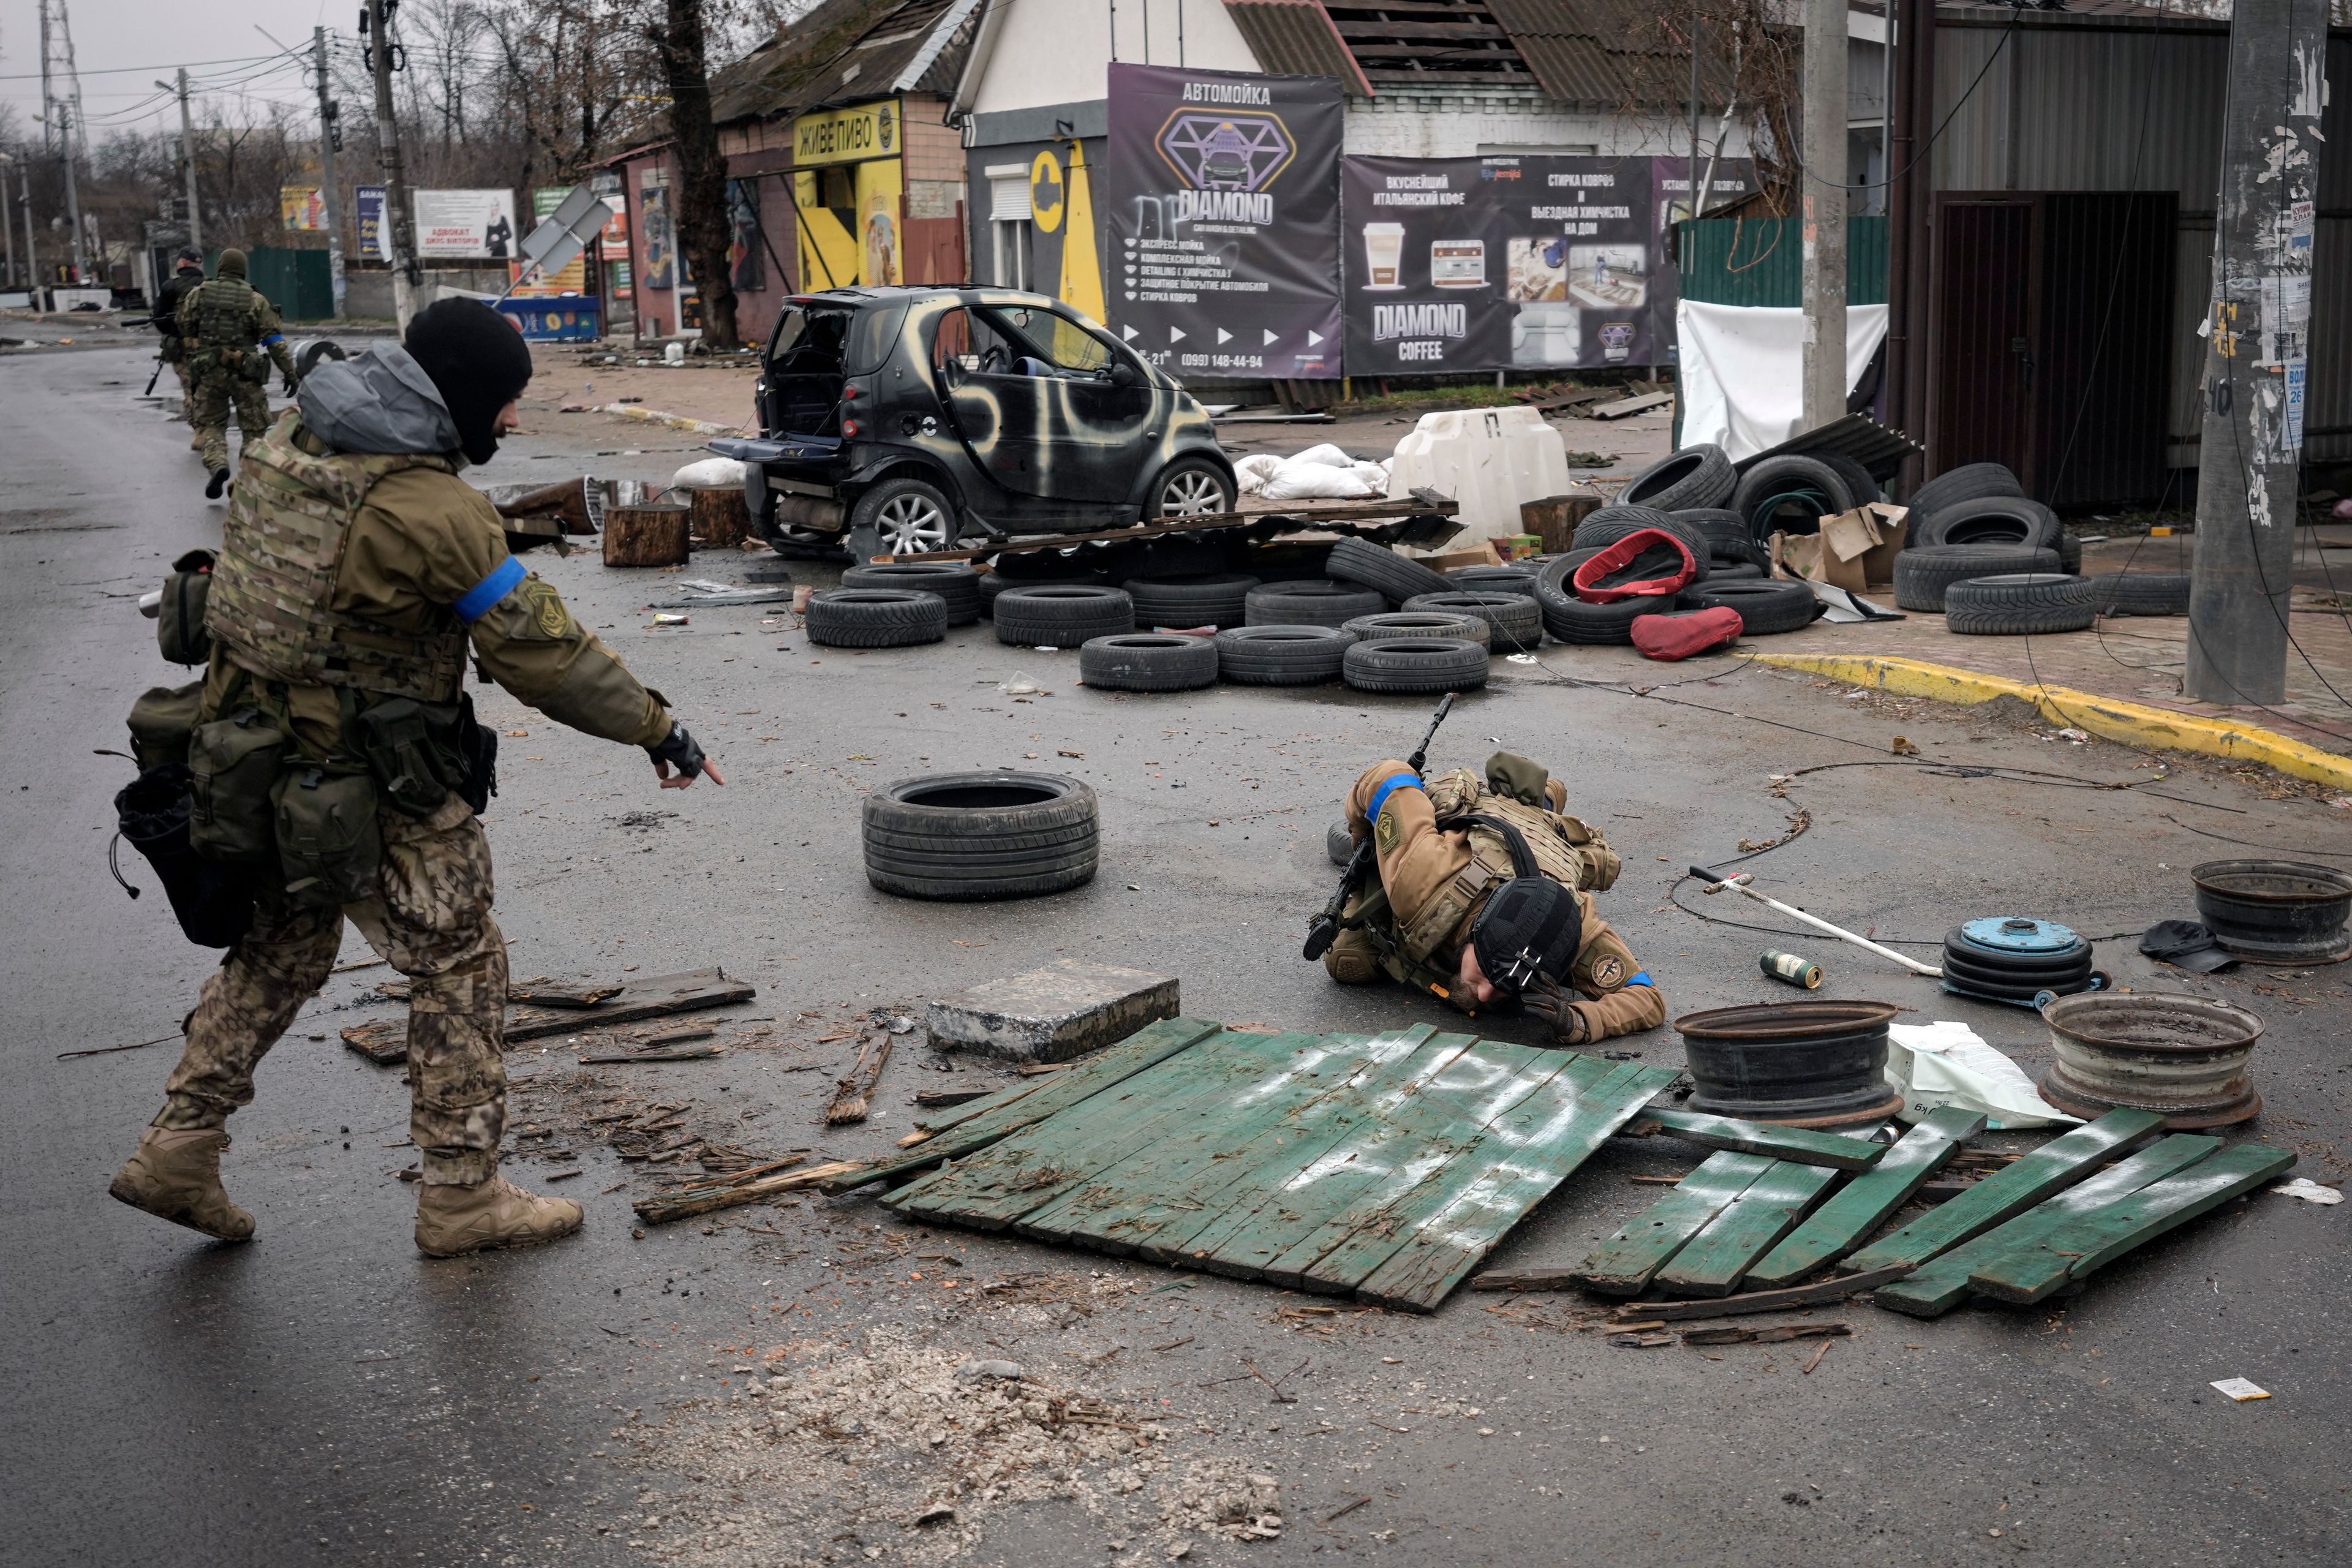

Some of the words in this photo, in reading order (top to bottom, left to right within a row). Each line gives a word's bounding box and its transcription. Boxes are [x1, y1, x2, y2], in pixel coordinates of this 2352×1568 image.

[1183, 82, 1272, 105] АВТОМОЙКА
[800, 123, 834, 156] ЖИВЕ
[837, 116, 872, 151] ПИВО
[1387, 175, 1449, 189] ВКУСНЕЙШИЙ
[1548, 174, 1581, 186] СТИРКА
[1581, 174, 1615, 186] КОВРОВ
[1373, 190, 1438, 205] ИТАЛЬЯНСКИЙ
[1440, 193, 1465, 205] КОФЕ
[1578, 190, 1585, 202] И
[1177, 189, 1273, 225] DIAMOND
[1532, 206, 1578, 219] ВЫЕЗДНАЯ
[1580, 206, 1630, 218] ХИМЧИСТКА
[2293, 203, 2311, 216] КУПИМ
[2293, 211, 2311, 222] ХЛАМ
[1564, 222, 1577, 235] НА
[1578, 222, 1597, 235] ДОМ
[1140, 239, 1178, 249] ЭКСПРЕСС
[1179, 239, 1204, 251] МОЙКА
[1140, 254, 1194, 264] КОМПЛЕКСНАЯ
[1195, 255, 1222, 265] МОЙКА
[1140, 266, 1176, 276] DETAILING
[1182, 268, 1226, 277] ХИМЧИСТКА
[1140, 279, 1179, 289] ЗАЩИТНОЕ
[1180, 279, 1219, 290] ПОКРЫТИЕ
[1221, 281, 1269, 292] АВТОМОБИЛЯ
[1140, 292, 1168, 301] СТИРКА
[1169, 292, 1197, 303] КОВРОВ
[1374, 303, 1466, 341] DIAMOND
[1399, 341, 1443, 360] COFFEE
[1212, 354, 1262, 368] 148-44-94
[2290, 390, 2302, 403] 26
